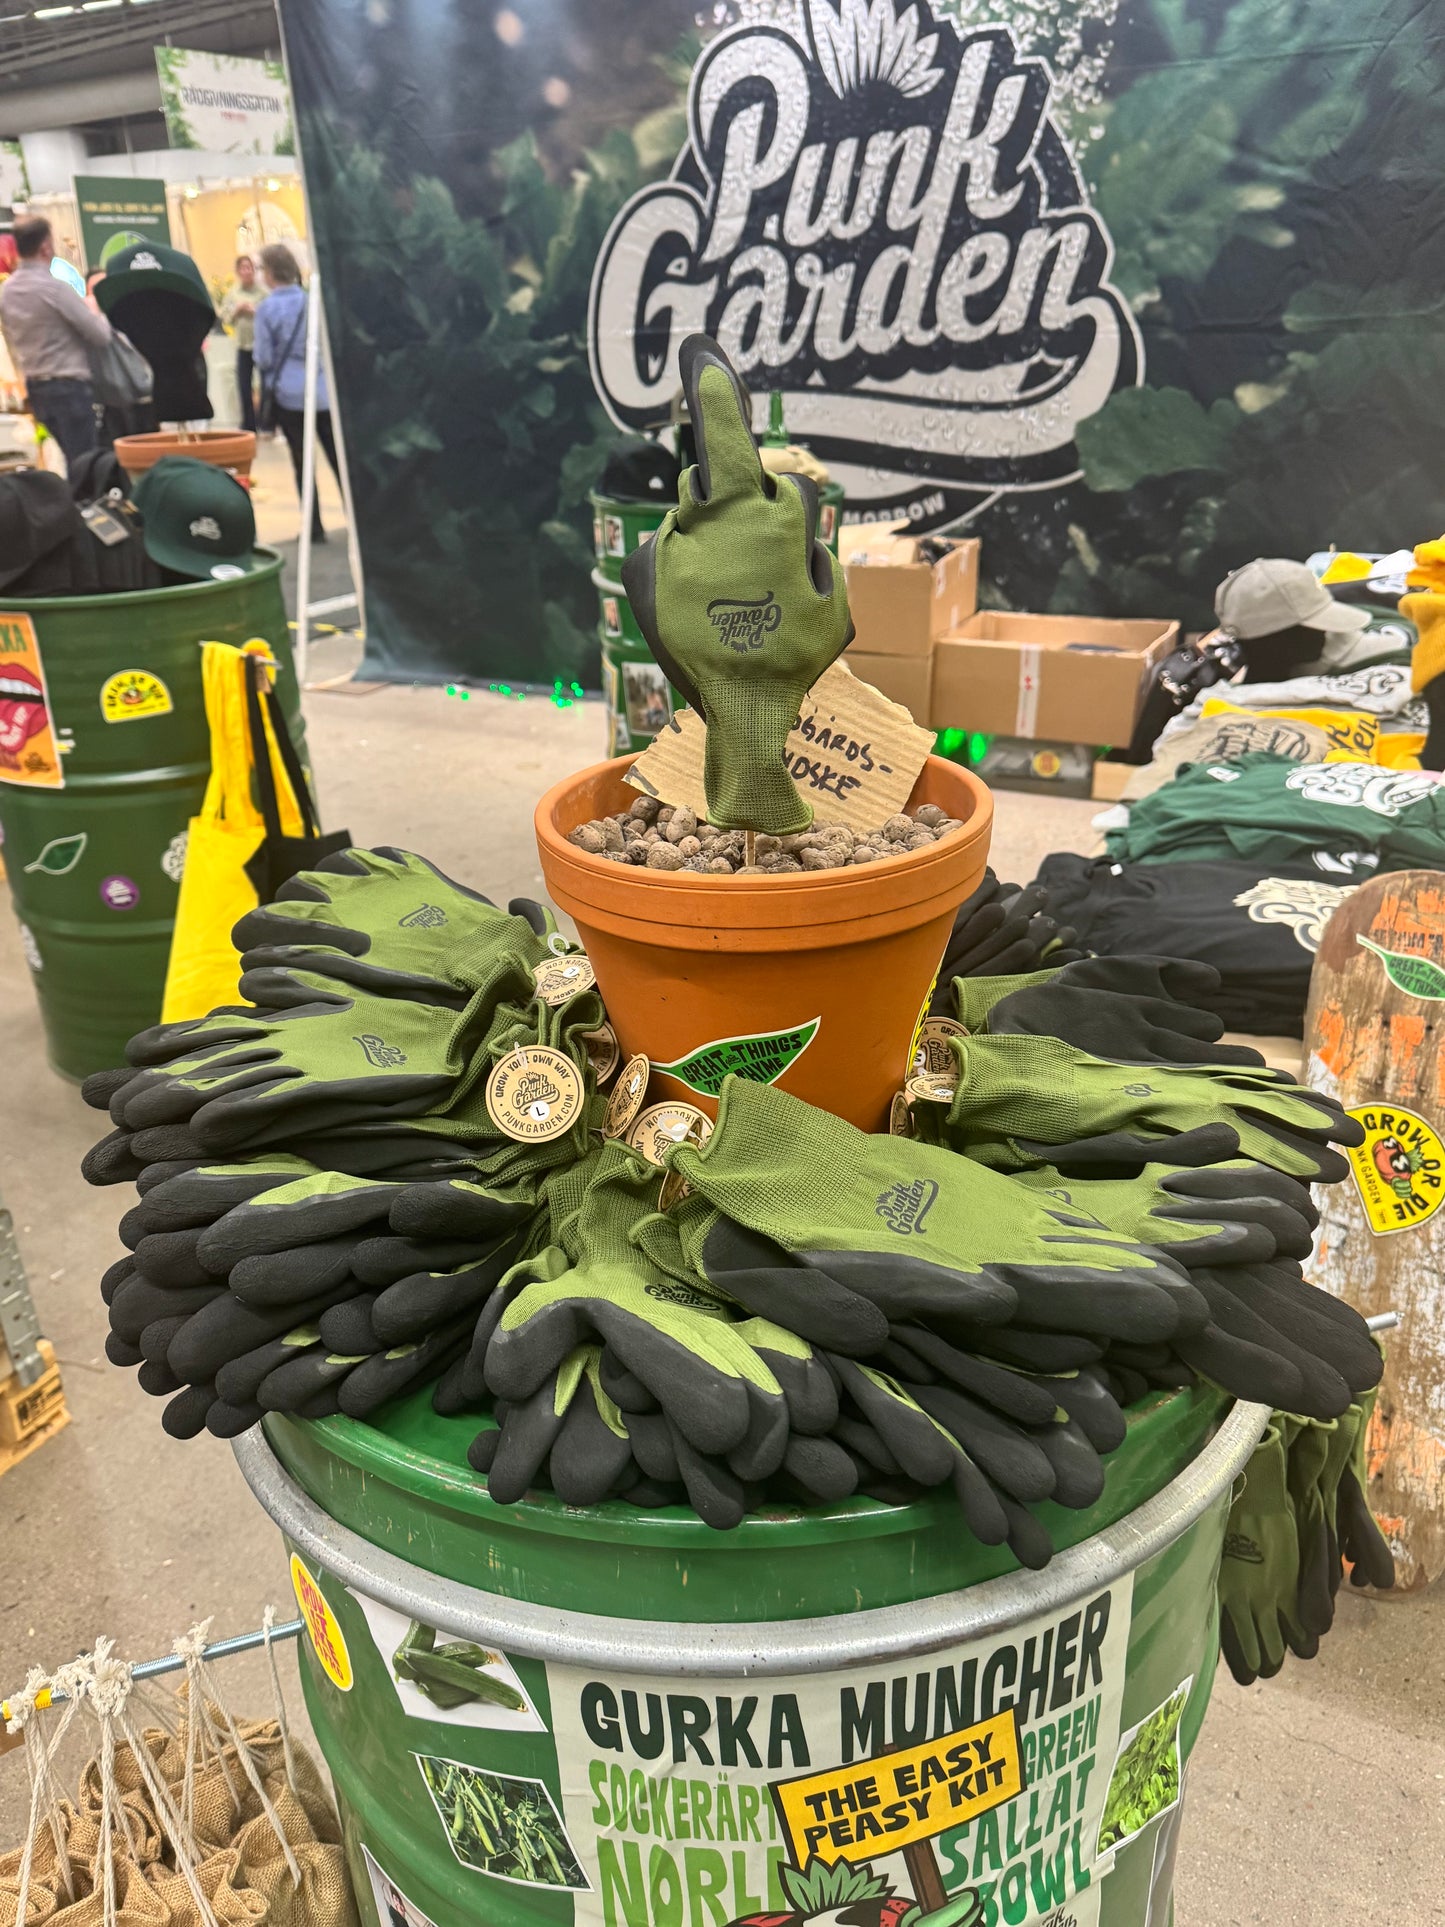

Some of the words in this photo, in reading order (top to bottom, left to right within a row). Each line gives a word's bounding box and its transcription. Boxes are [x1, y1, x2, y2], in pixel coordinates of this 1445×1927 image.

[698, 34, 1028, 263] Punk
[600, 195, 1093, 408] Garden
[711, 603, 782, 632] Garden
[720, 623, 765, 648] Punk
[495, 1071, 510, 1098] GROW
[532, 1054, 554, 1066] OWN
[553, 1062, 571, 1079] WAY
[682, 1048, 729, 1083] GREAT
[729, 1033, 802, 1063] THINGS
[511, 1083, 557, 1109] Garden
[518, 1074, 548, 1093] Punk
[502, 1094, 575, 1133] PUNKGARDEN.COM
[535, 1106, 545, 1117] L
[1363, 1113, 1430, 1151] GROW
[1361, 1166, 1382, 1204] GARDEN
[1420, 1159, 1441, 1188] OR
[875, 1182, 911, 1221] Punk
[886, 1179, 926, 1235] Garden
[1392, 1192, 1430, 1221] DIE
[580, 1681, 811, 1768] GURKA
[840, 1589, 1112, 1763] MUNCHER
[1022, 1694, 1101, 1783] GREEN
[804, 1776, 882, 1822] THE
[898, 1732, 994, 1792] EASY
[588, 1759, 777, 1843] SOCKERÄRT
[803, 1793, 934, 1853] PEASY
[950, 1758, 1007, 1807] KIT
[939, 1754, 1095, 1890] SALLAT
[596, 1835, 787, 1927] NORLI
[979, 1816, 1091, 1927] BOWL
